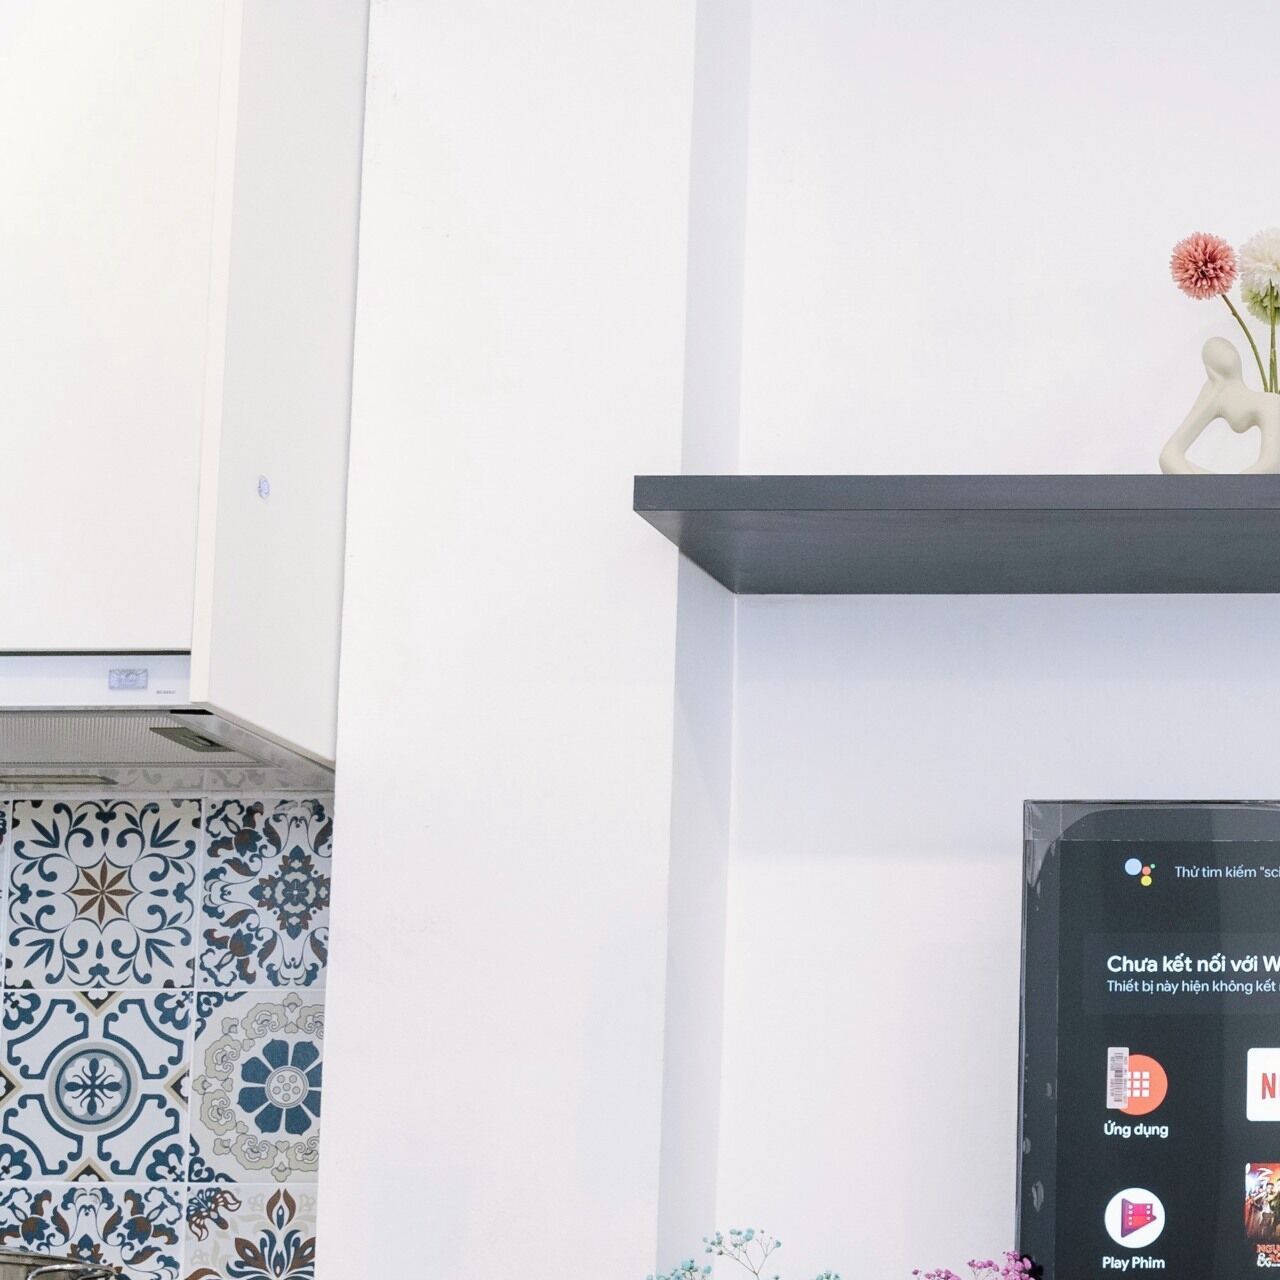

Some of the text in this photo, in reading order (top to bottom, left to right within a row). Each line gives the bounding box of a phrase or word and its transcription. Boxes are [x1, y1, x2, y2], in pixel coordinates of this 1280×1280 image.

[1174, 864, 1200, 879] Thử
[1225, 863, 1257, 879] kiếm
[1106, 954, 1158, 973] Chưa
[1162, 952, 1193, 973] kết
[1197, 952, 1226, 973] nối
[1230, 954, 1258, 973] với
[1106, 978, 1140, 993] Thiết
[1141, 979, 1155, 995] bị
[1156, 980, 1179, 995] này
[1181, 979, 1210, 995] hiện
[1212, 979, 1254, 995] không
[1255, 978, 1277, 993] kết
[1103, 1119, 1169, 1139] Ứng dụng
[1102, 1256, 1166, 1272] Play Phim
